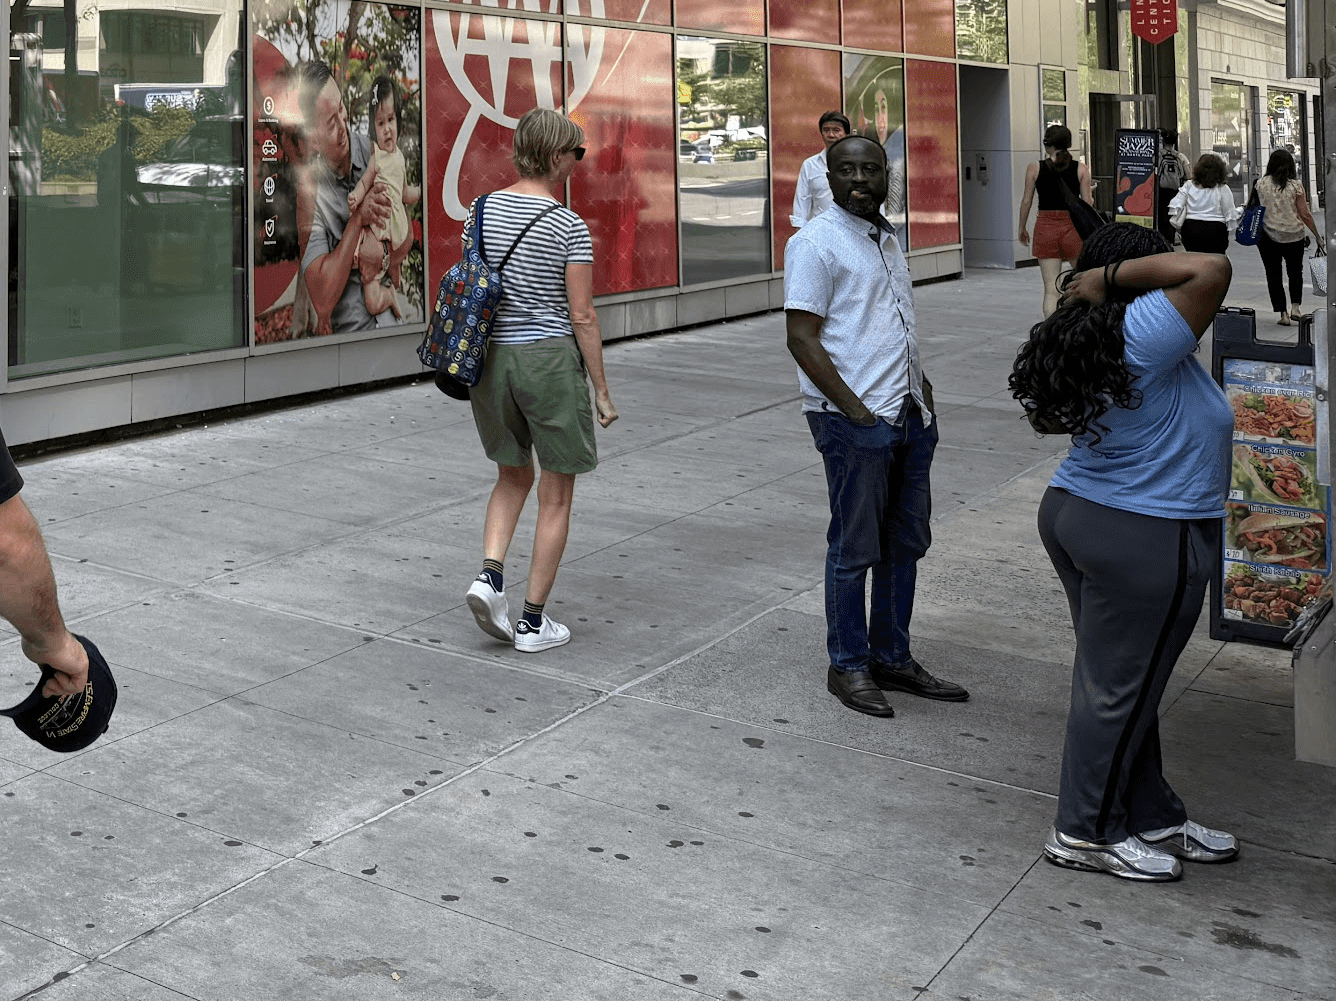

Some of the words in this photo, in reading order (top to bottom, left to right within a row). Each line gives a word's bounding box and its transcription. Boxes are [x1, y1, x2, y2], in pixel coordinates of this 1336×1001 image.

[1244, 385, 1276, 395] Chicken
[1297, 389, 1314, 398] Ric
[1251, 445, 1284, 456] Chicken
[1285, 447, 1305, 458] Gyro
[1274, 507, 1310, 519] Sausage
[57, 722, 79, 737] STATE
